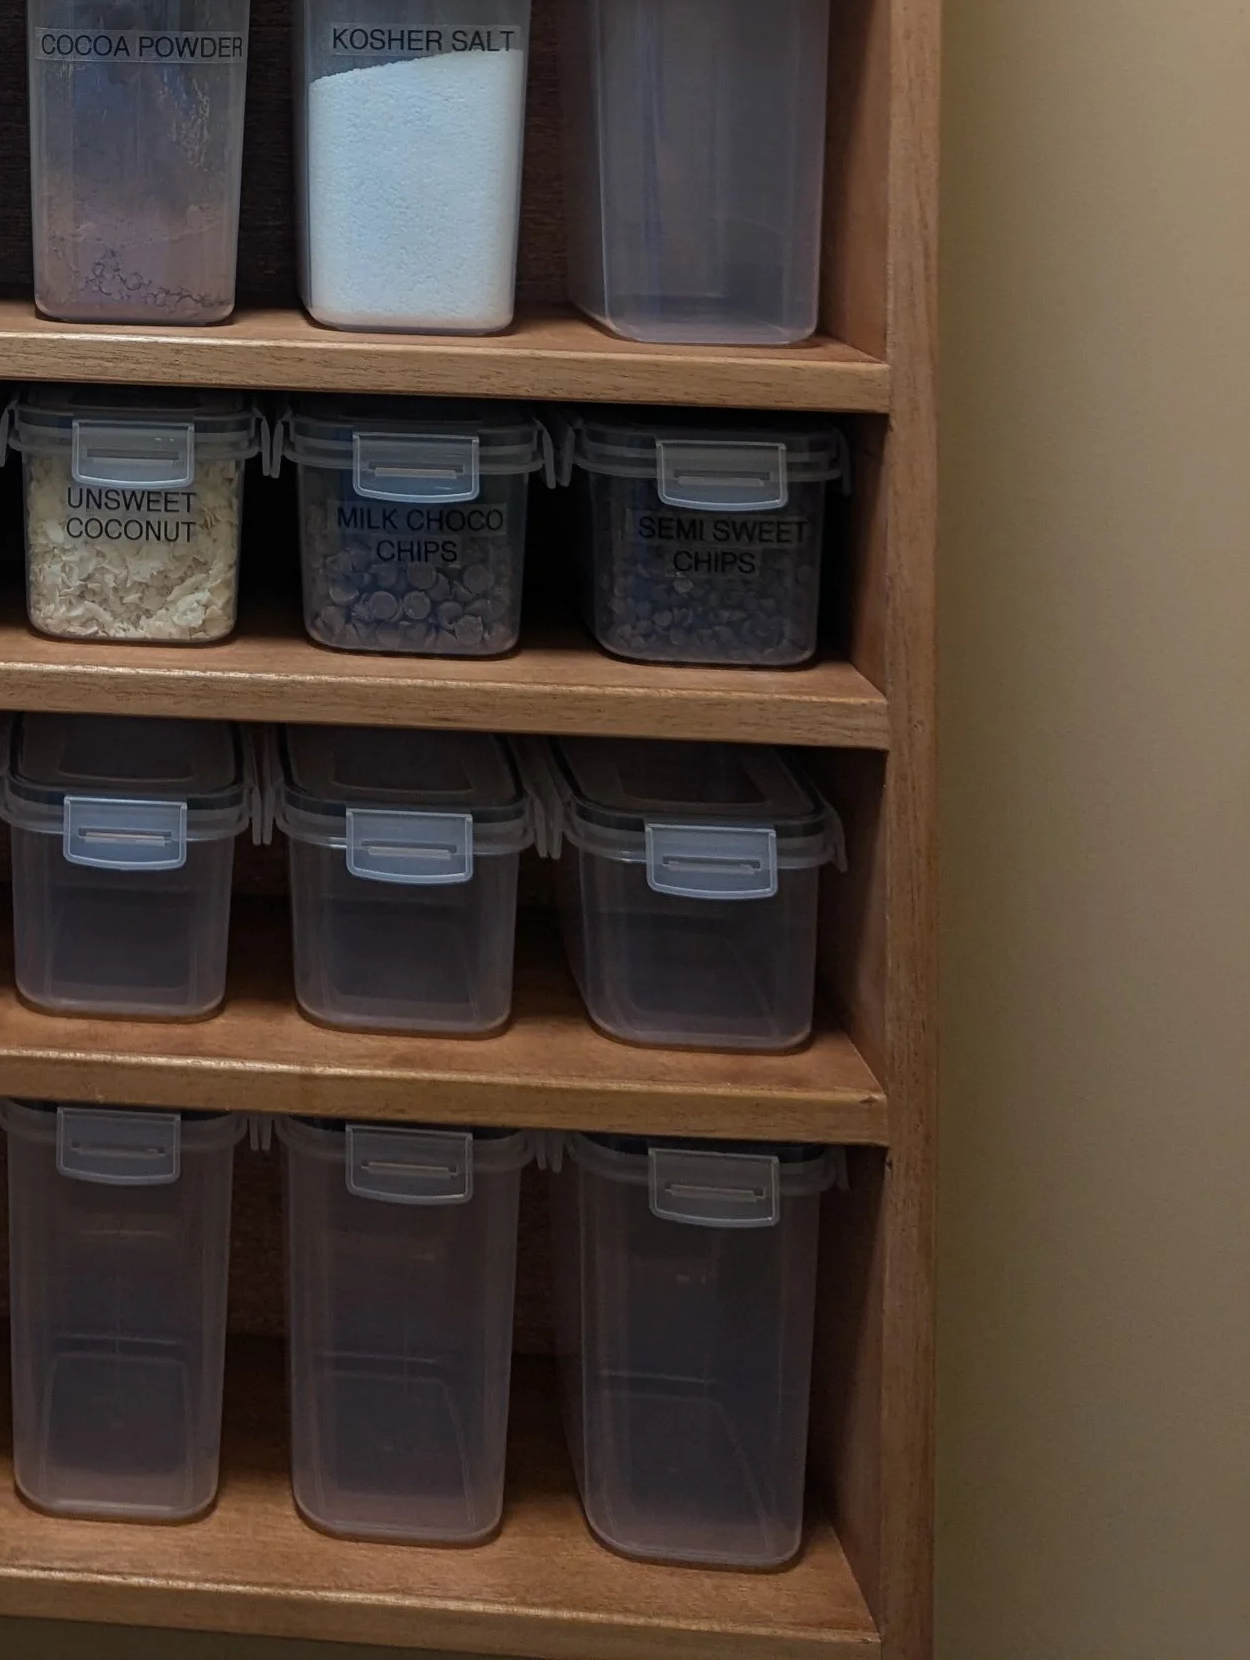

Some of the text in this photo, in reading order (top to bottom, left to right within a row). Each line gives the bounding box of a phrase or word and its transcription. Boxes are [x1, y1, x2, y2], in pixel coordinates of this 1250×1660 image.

[41, 33, 243, 59] COCOA POWDER
[332, 27, 517, 53] KOSHER SALT
[66, 487, 196, 514] UNSWEET
[66, 516, 196, 543] COCONUT
[337, 504, 504, 533] MILK CHOCO
[638, 514, 809, 545] SEMI SWEET
[376, 538, 459, 565] CHIPS
[672, 549, 756, 576] CHIPS
